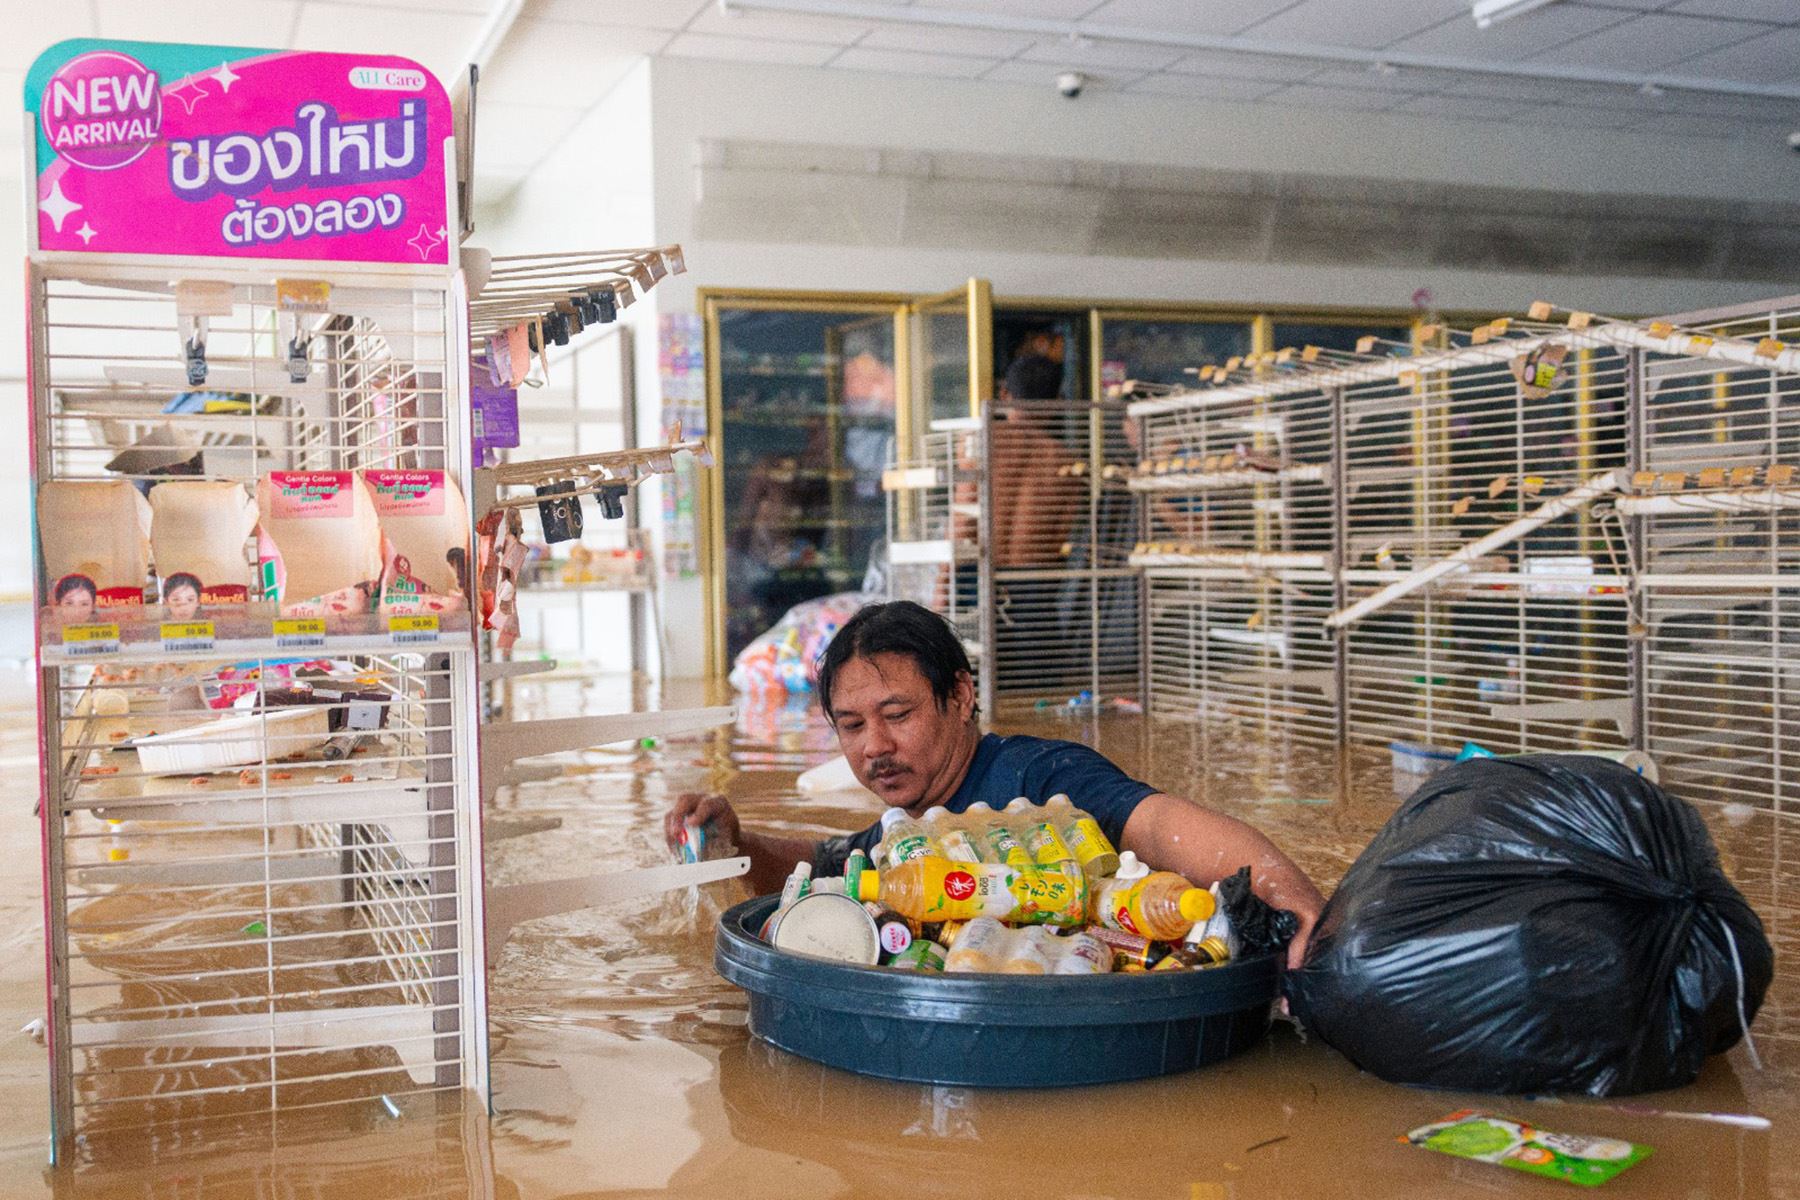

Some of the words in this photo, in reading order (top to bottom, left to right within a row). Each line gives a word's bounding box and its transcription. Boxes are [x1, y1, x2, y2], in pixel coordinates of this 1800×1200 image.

[54, 73, 156, 117] NEW
[385, 72, 421, 87] Care
[55, 117, 158, 147] ARRIVAL
[171, 101, 415, 190] ของใหม่
[222, 194, 402, 243] ต้องลอง
[312, 475, 337, 483] Colors
